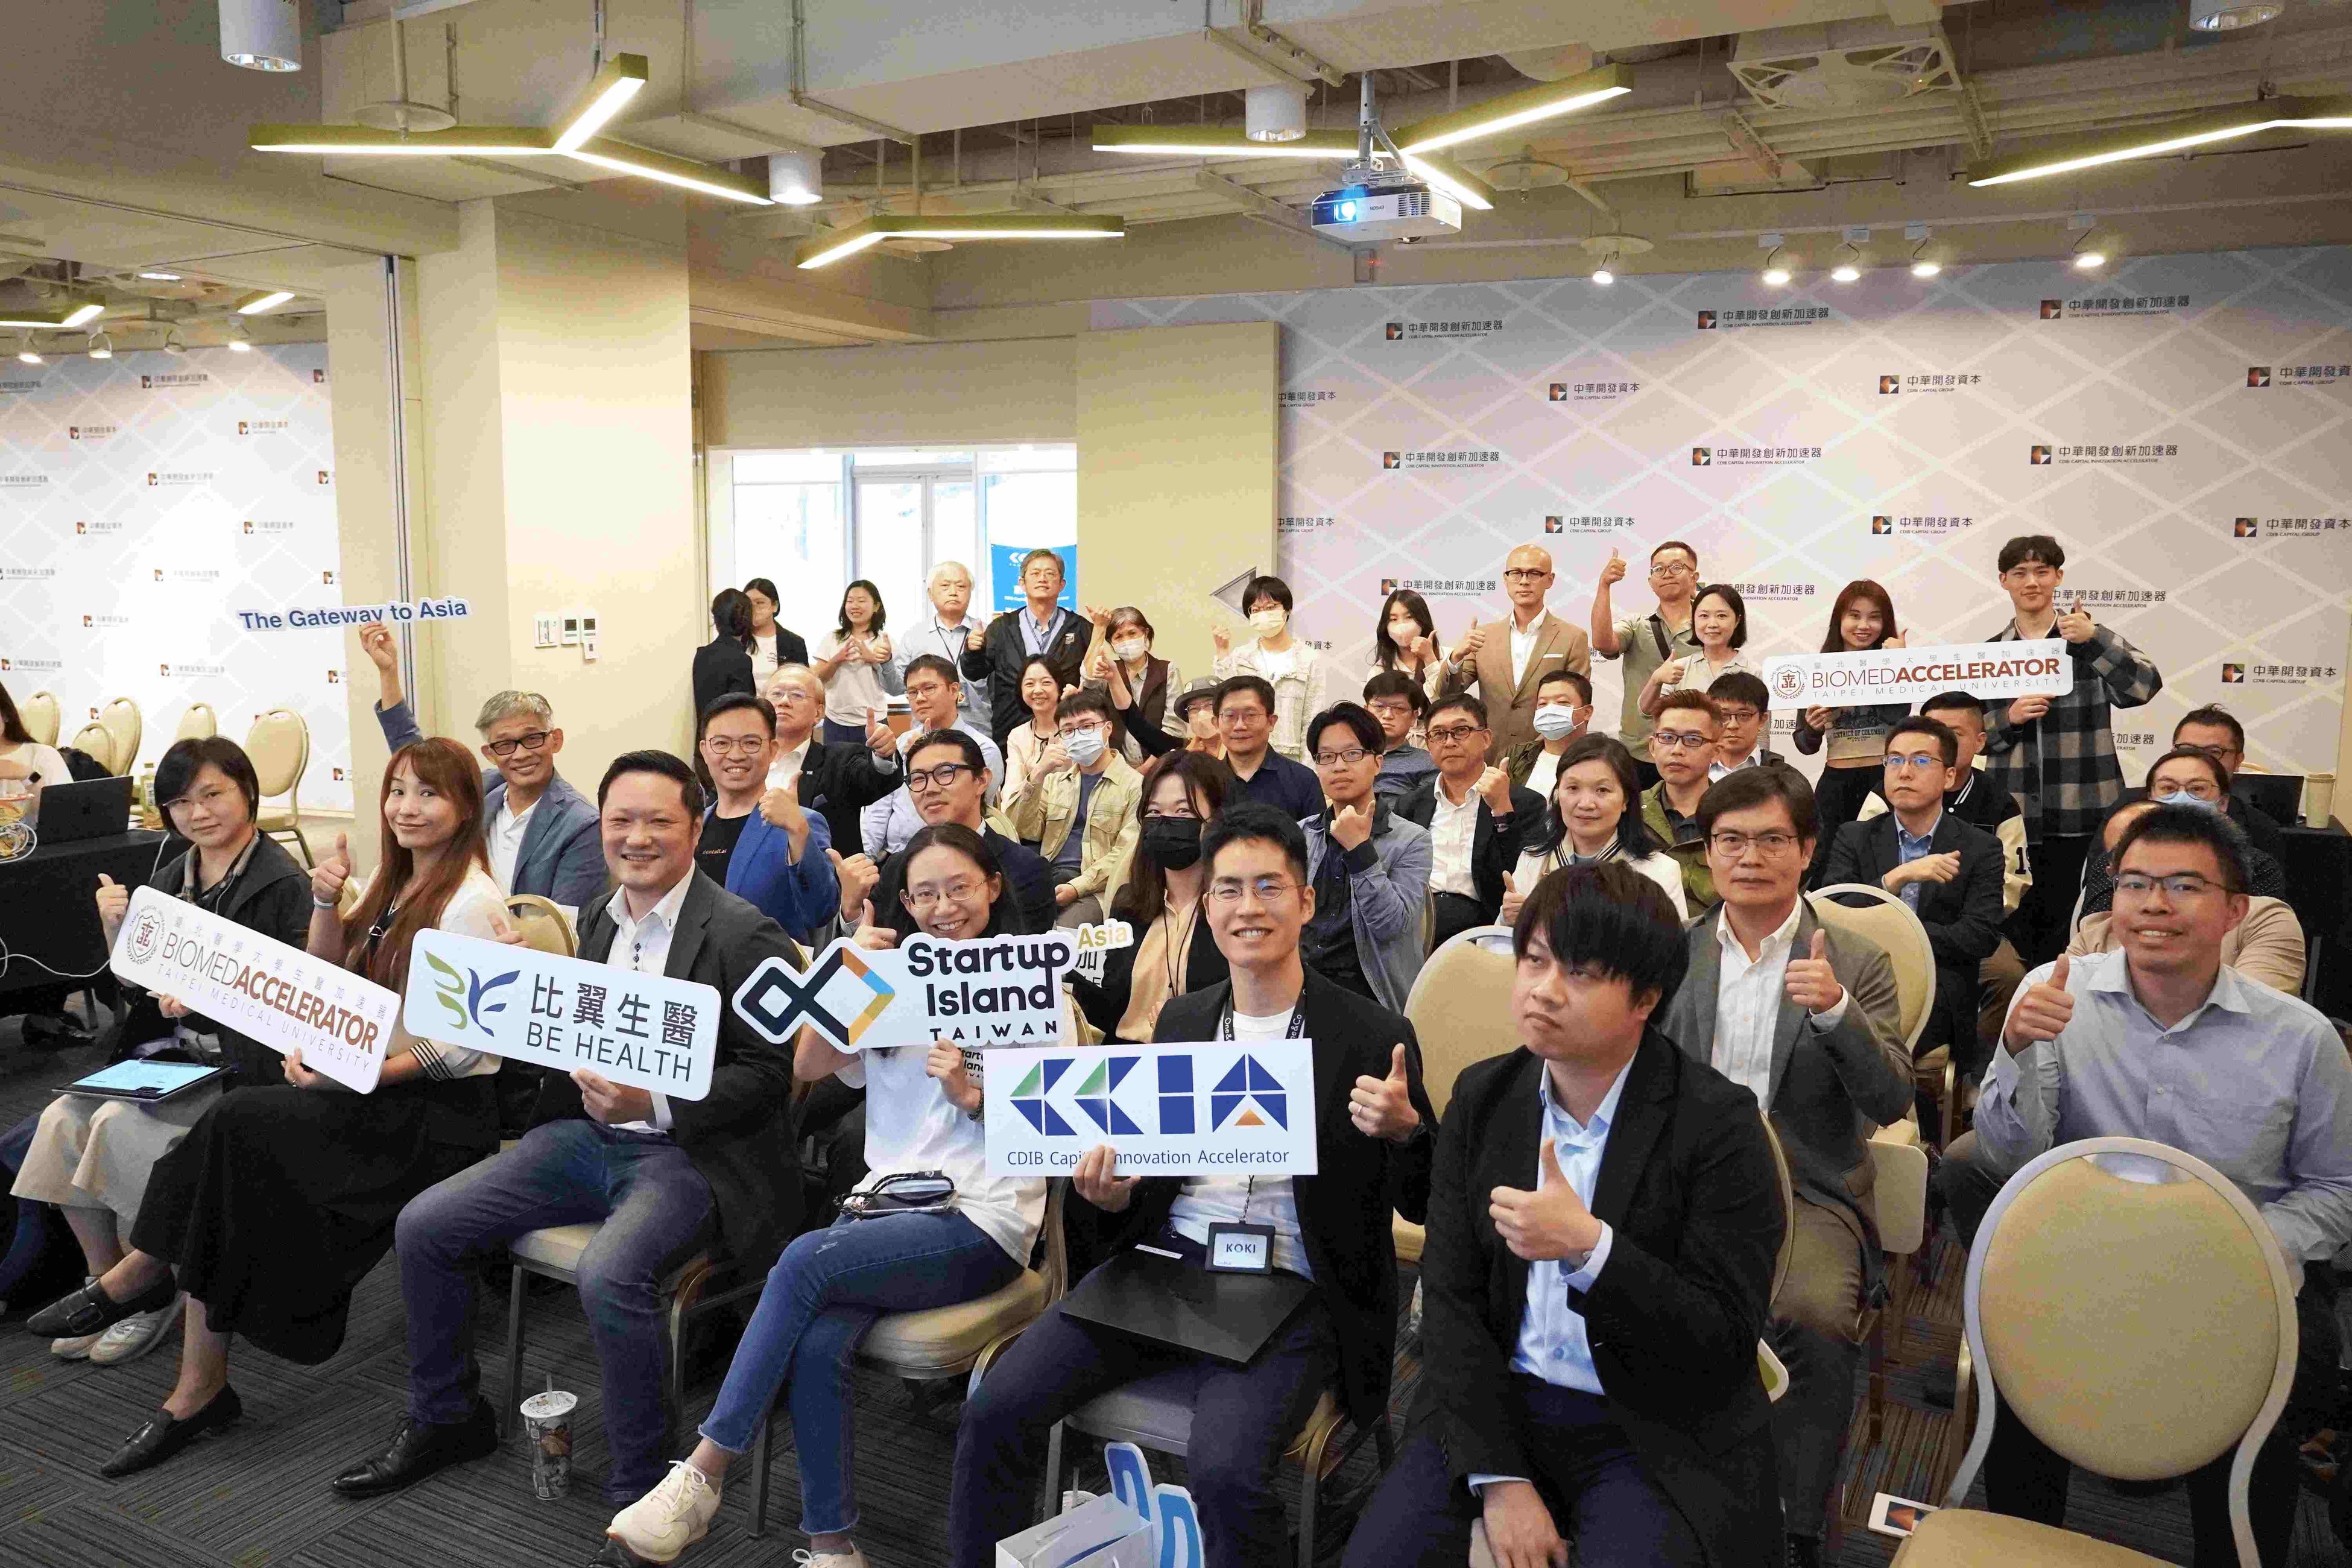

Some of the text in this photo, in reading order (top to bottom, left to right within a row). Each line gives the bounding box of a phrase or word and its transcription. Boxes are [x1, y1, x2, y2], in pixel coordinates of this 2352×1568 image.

[2069, 296, 2189, 311] 中華開發創新加速器
[1723, 308, 1829, 321] 中華開發創新加速器
[1408, 320, 1502, 334] 中華開發創新加速器
[1908, 375, 1982, 386] 中華開發資本
[1574, 382, 1640, 393] 中華開發資本
[1278, 391, 1336, 401] 中華開發資本
[1406, 451, 1499, 462] 中華開發創新加速器
[1717, 447, 1821, 458] 中華開發創新加速器
[2059, 444, 2178, 457] 中華開發創新加速器
[1277, 517, 1335, 527] 中華開發資本
[1570, 517, 1635, 526] 中華開發資本
[1900, 517, 1973, 527] 中華開發資本
[2266, 518, 2351, 530] 中華開發資本
[1403, 580, 1496, 590] 中華開發創新加速器
[1734, 584, 1815, 595] 開發創新加速器
[2053, 589, 2166, 602] 中華開發創新加速器
[239, 599, 468, 629] The Gateway to Asia
[1812, 658, 2061, 688] BIOMEDACCELERATOR
[2253, 665, 2337, 677] 中華開發資本
[1812, 677, 2061, 698] TAIPEI MEDICAL UNIVERSITY
[1077, 923, 1127, 949] Asia
[908, 941, 1070, 978] Startup
[162, 932, 379, 1054] BIOMEDACCELERATOR
[926, 981, 1055, 1017] Island
[156, 963, 370, 1072] TAIPEI MEDICAL UNIVERSITY
[530, 973, 698, 1049] 比翼生醫
[929, 1019, 1058, 1042] TAIWAN
[526, 1022, 692, 1083] BE HEALTH
[1007, 1148, 1289, 1169] CDIB Capi nnovation Accelerator
[1225, 1244, 1256, 1253] KOKI
